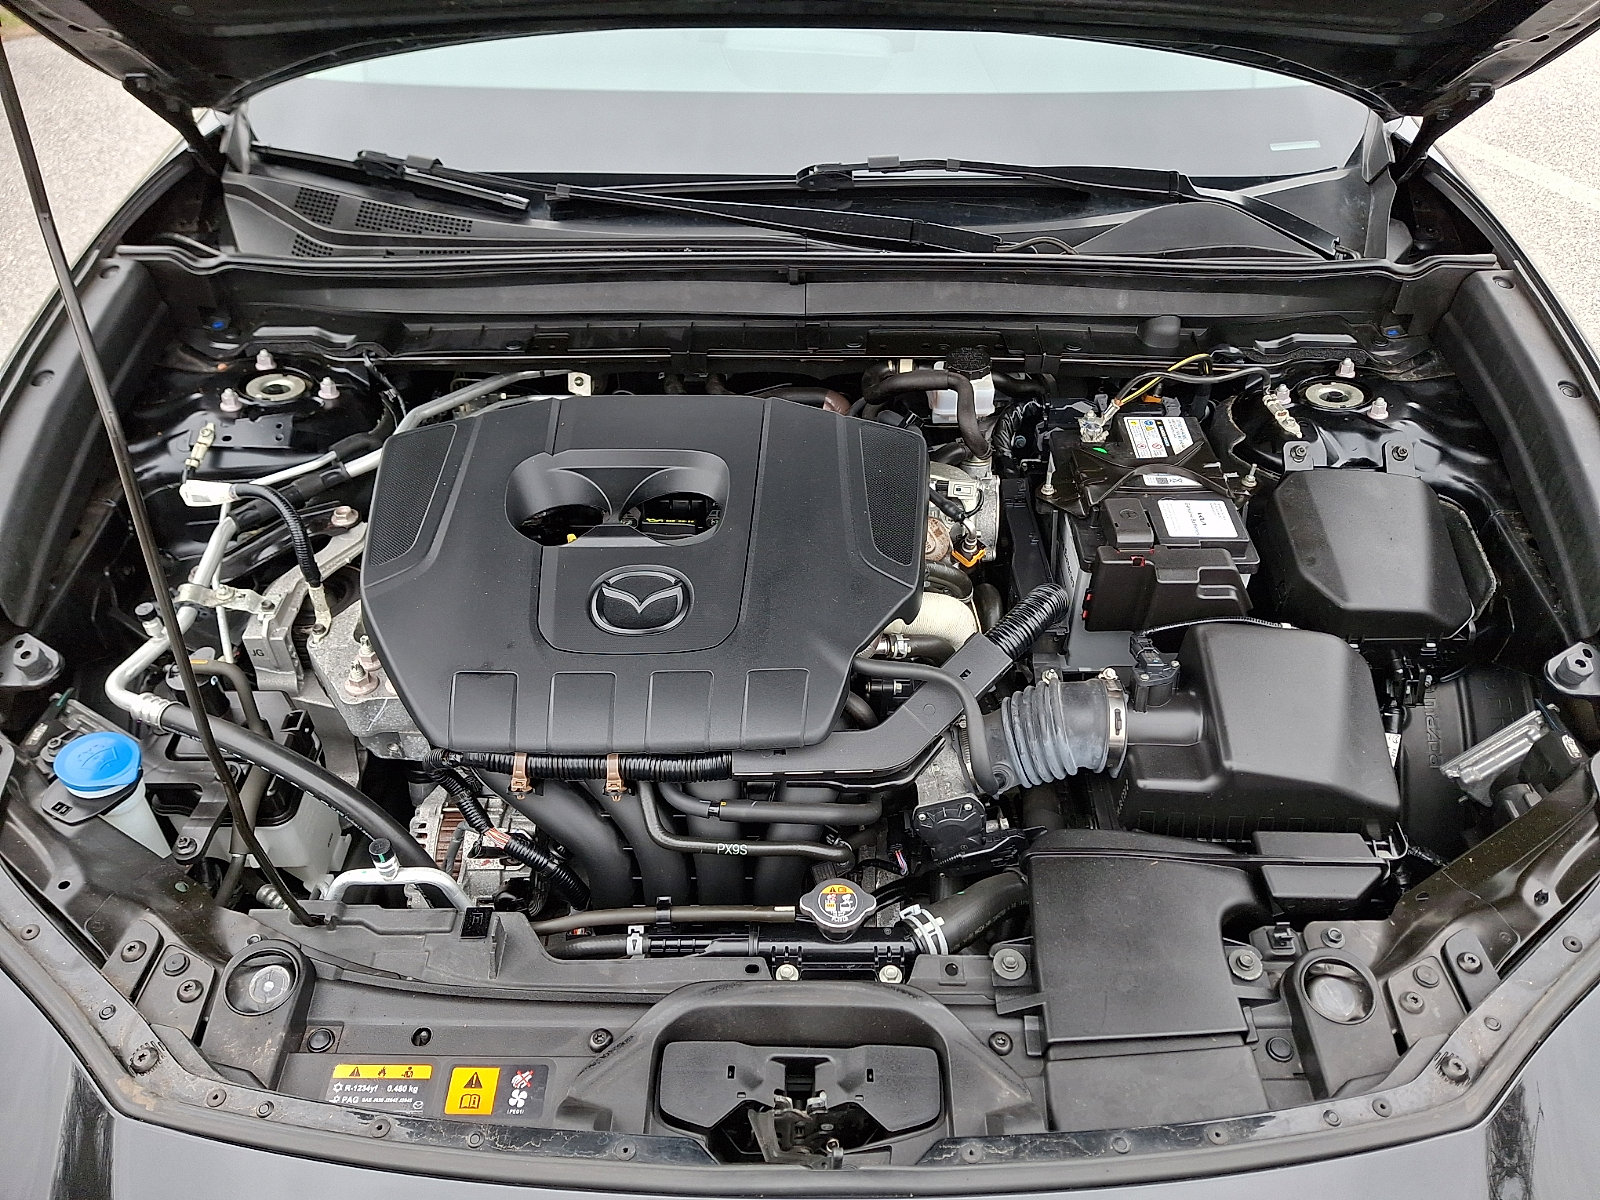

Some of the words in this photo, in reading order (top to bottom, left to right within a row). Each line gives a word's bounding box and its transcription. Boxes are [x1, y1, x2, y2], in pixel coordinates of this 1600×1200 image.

[717, 843, 748, 855] PX9S
[408, 1085, 418, 1094] kg
[341, 1096, 359, 1104] PAG
